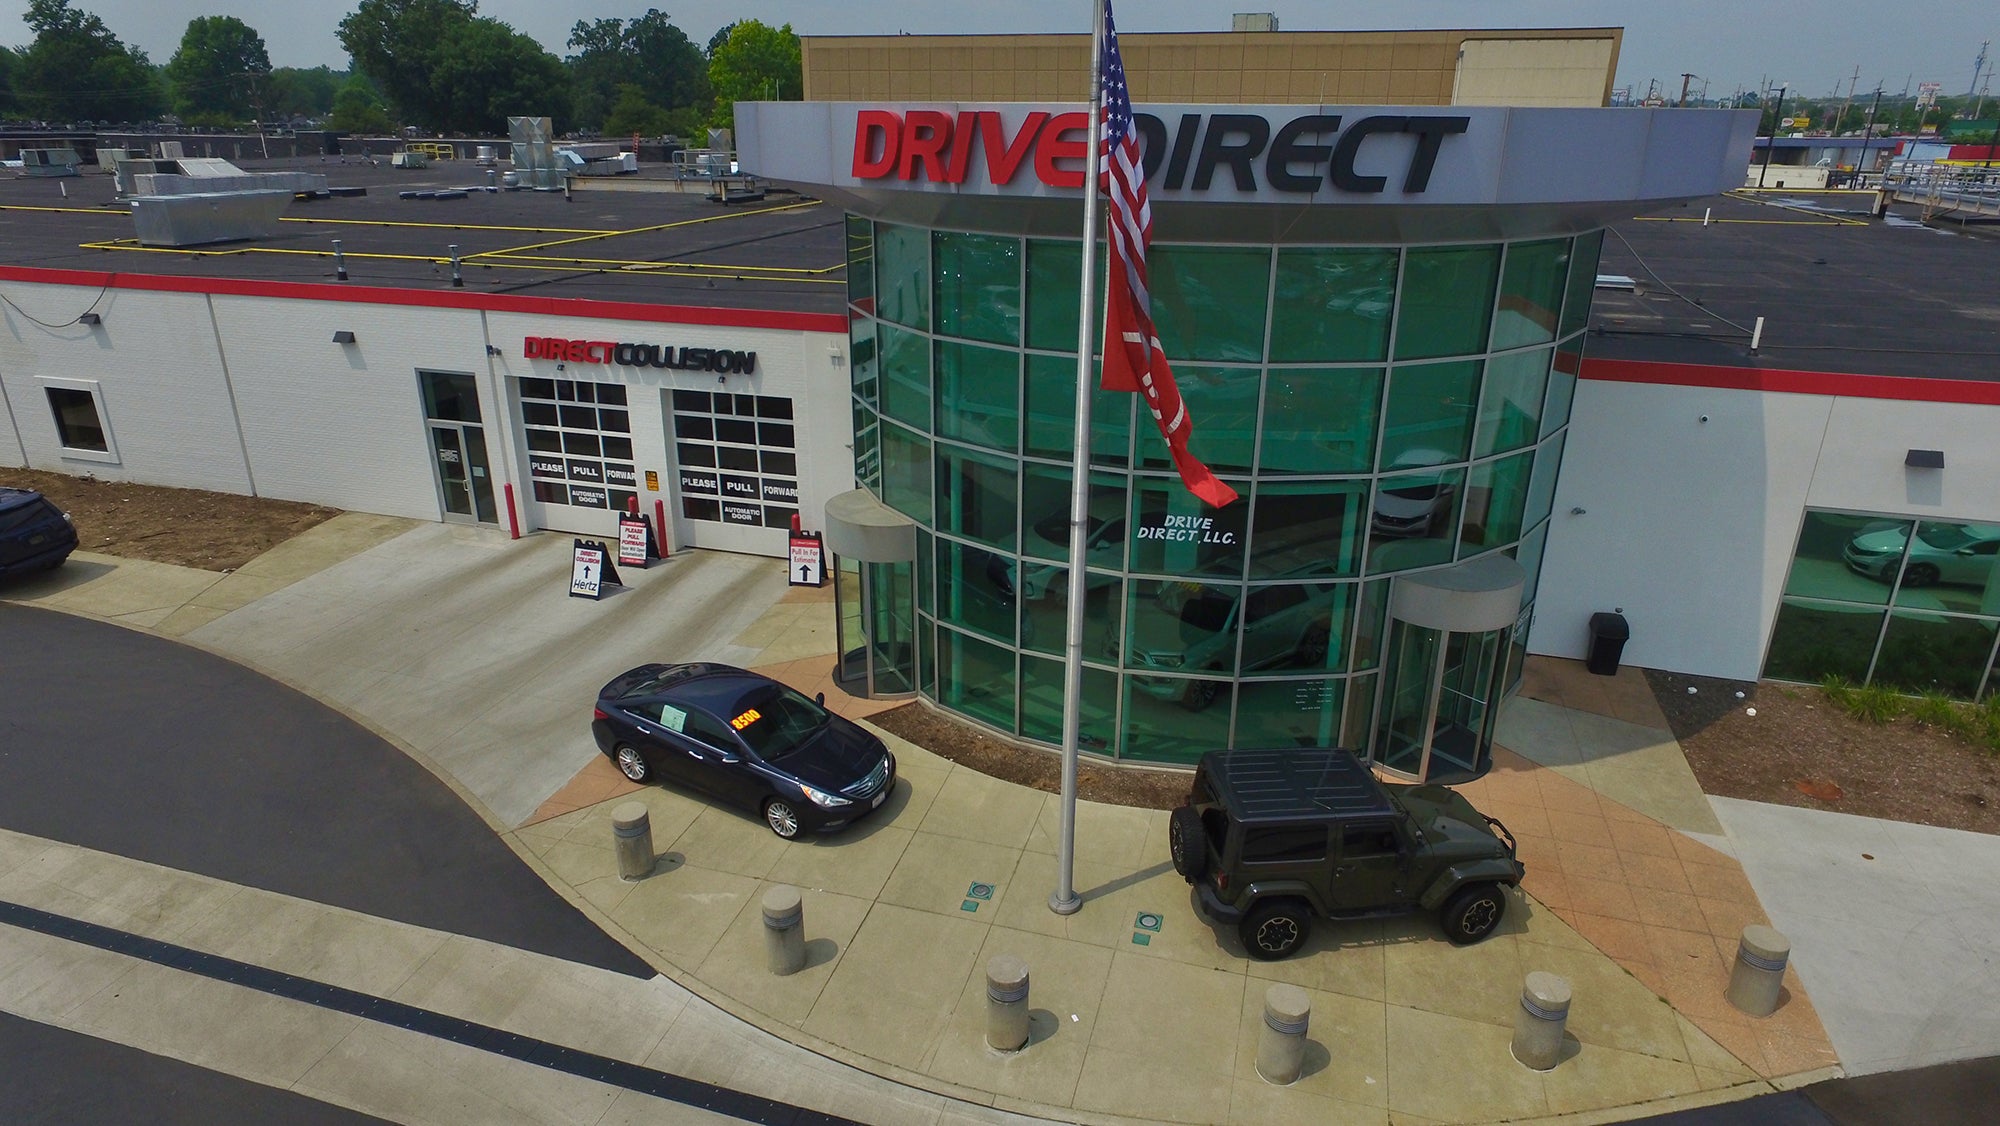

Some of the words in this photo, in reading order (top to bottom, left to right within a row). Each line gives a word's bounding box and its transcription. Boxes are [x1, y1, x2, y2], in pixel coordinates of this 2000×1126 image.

[531, 462, 564, 473] PLEASE
[573, 466, 599, 477] PULL
[606, 469, 636, 480] FORWAR
[681, 477, 717, 489] PLEASE
[726, 481, 754, 493] PULL
[571, 490, 605, 499] AUTOMATIC
[578, 496, 598, 504] DOOR
[724, 506, 761, 516] AUTOMATIC
[731, 513, 752, 521] DOOR
[1164, 514, 1214, 530] DRIVE
[576, 556, 600, 564] COLLISION
[573, 579, 598, 592] Hertz
[731, 708, 762, 730] 8500
